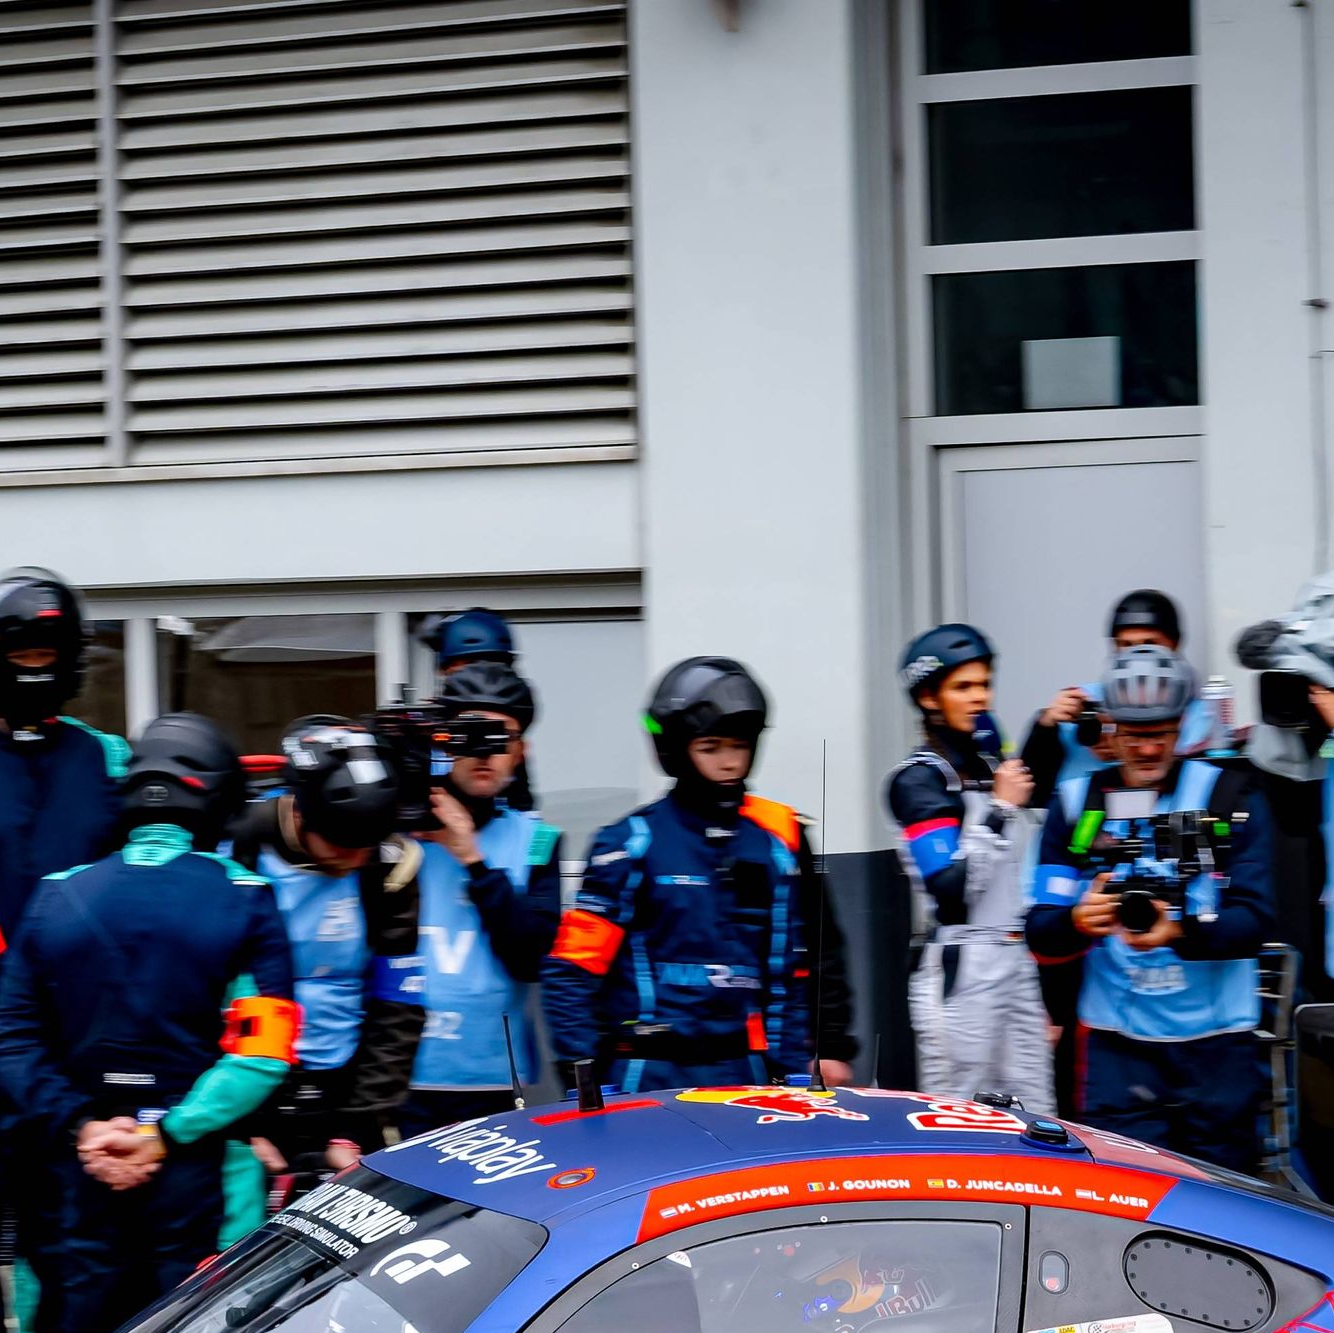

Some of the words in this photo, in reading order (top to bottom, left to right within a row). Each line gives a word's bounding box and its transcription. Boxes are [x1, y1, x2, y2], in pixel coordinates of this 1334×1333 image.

[427, 1122, 558, 1185] viaplay
[827, 1181, 840, 1192] J.
[842, 1178, 911, 1191] GOUNON
[946, 1179, 962, 1190] D.
[965, 1179, 1063, 1197] JUNCADELLA
[677, 1203, 696, 1214] M.
[697, 1185, 790, 1210] VERSTAPPEN
[1092, 1190, 1105, 1202] L.
[1109, 1193, 1149, 1209] AUER
[310, 1224, 360, 1260] SIMULATOR
